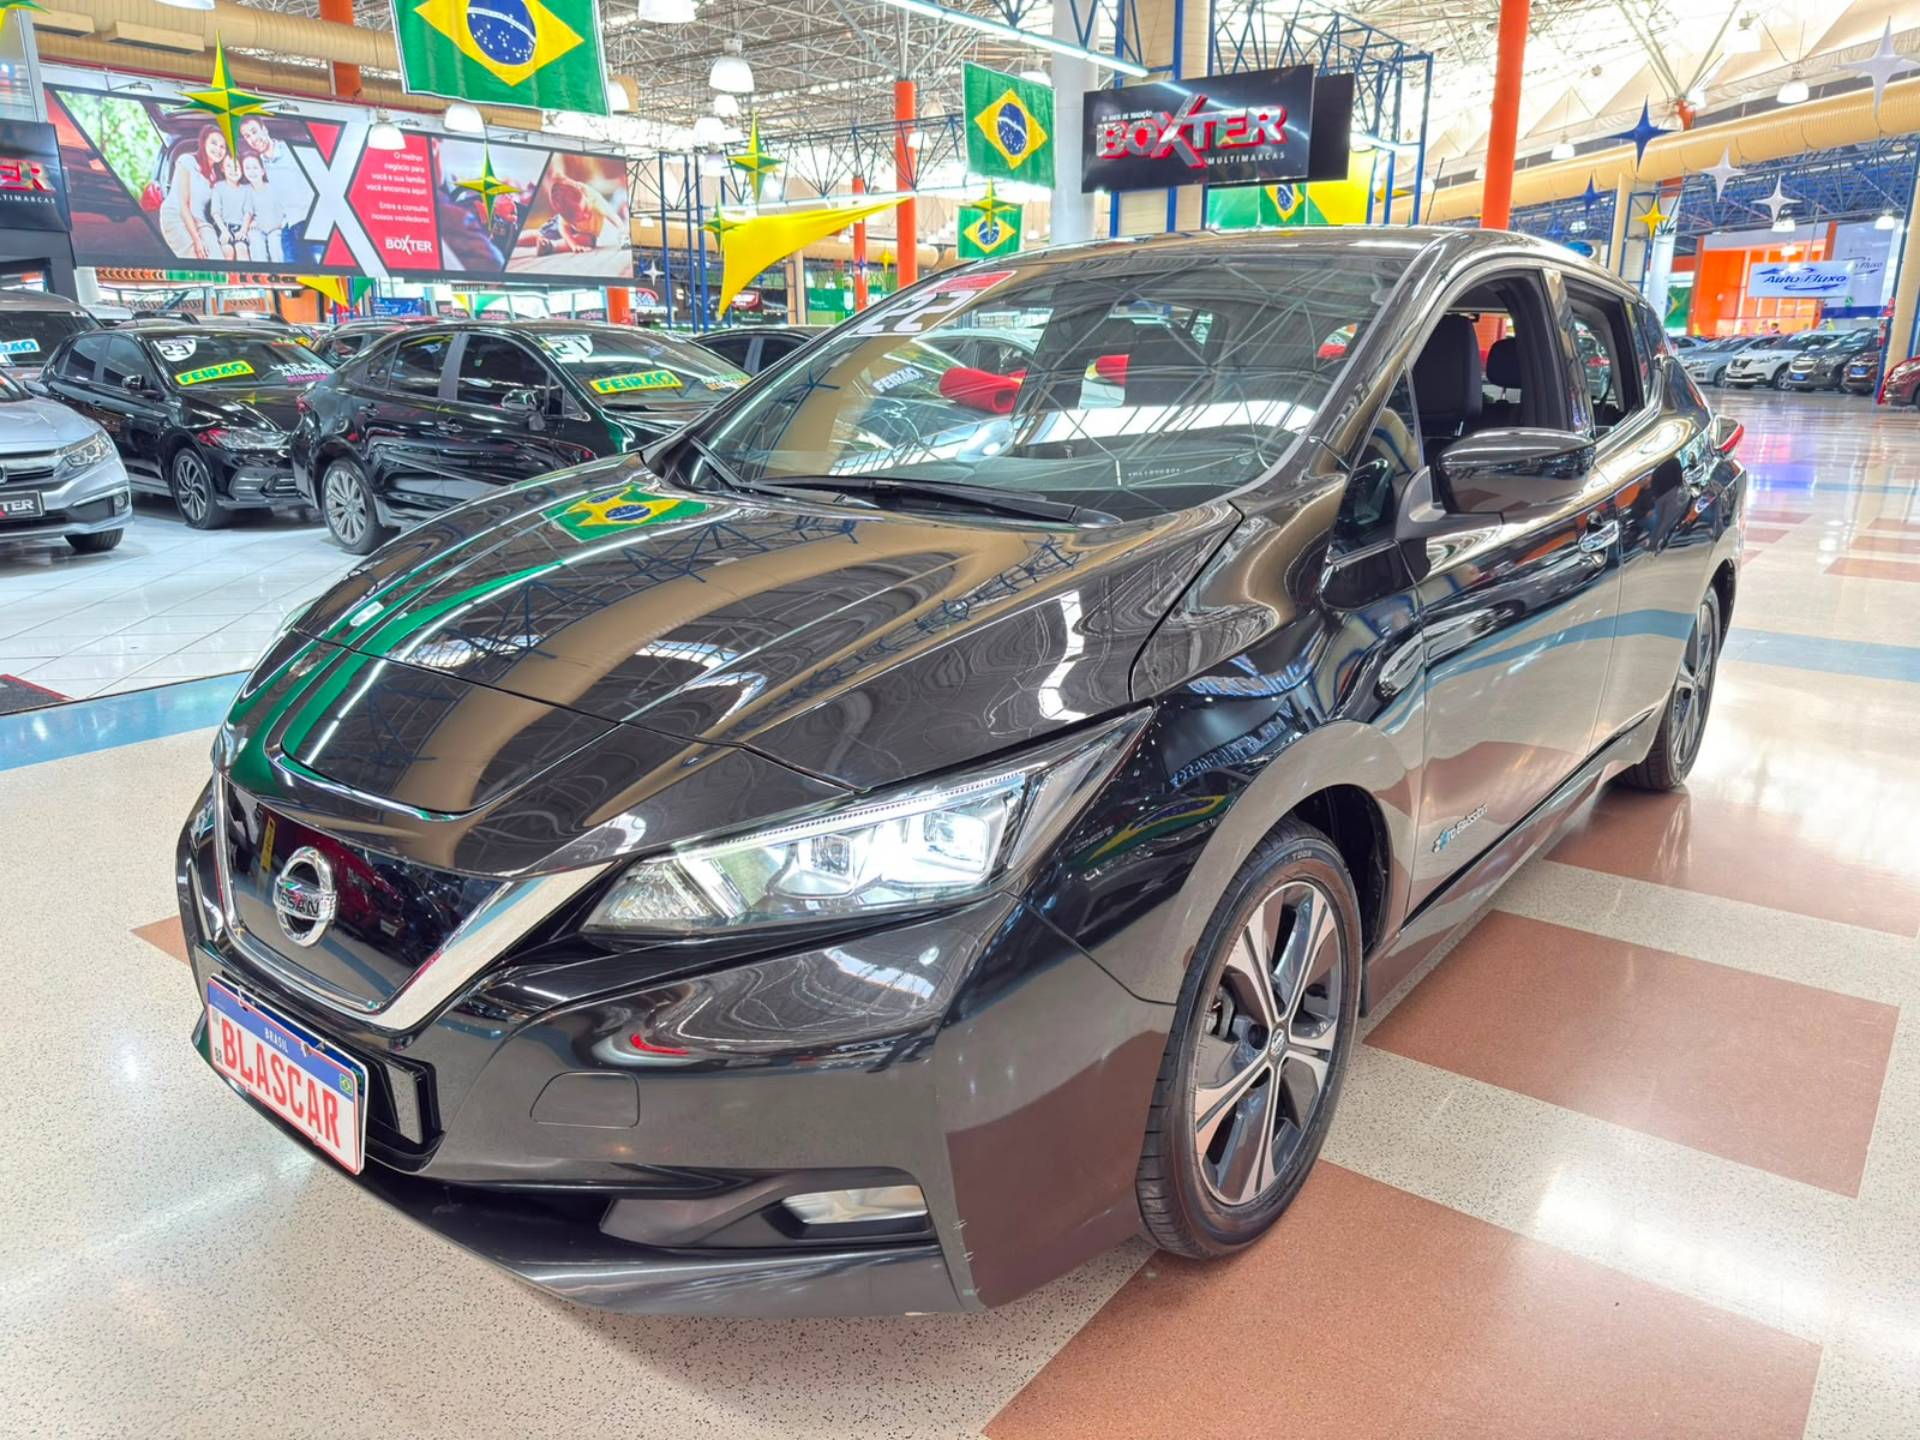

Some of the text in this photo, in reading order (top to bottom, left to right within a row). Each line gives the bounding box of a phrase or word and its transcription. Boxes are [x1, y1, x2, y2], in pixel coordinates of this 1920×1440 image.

[1096, 95, 1288, 169] BOXTER
[401, 153, 423, 161] melhor
[1207, 151, 1286, 165] MULTIMARCAS
[0, 194, 55, 204] TIMARCAS
[379, 201, 396, 210] Entre
[385, 235, 433, 256] BOXTER
[1763, 274, 1799, 283] Auto
[857, 290, 977, 334] 22
[264, 1027, 289, 1053] BRASIL
[221, 1017, 341, 1149] BLASCAR
